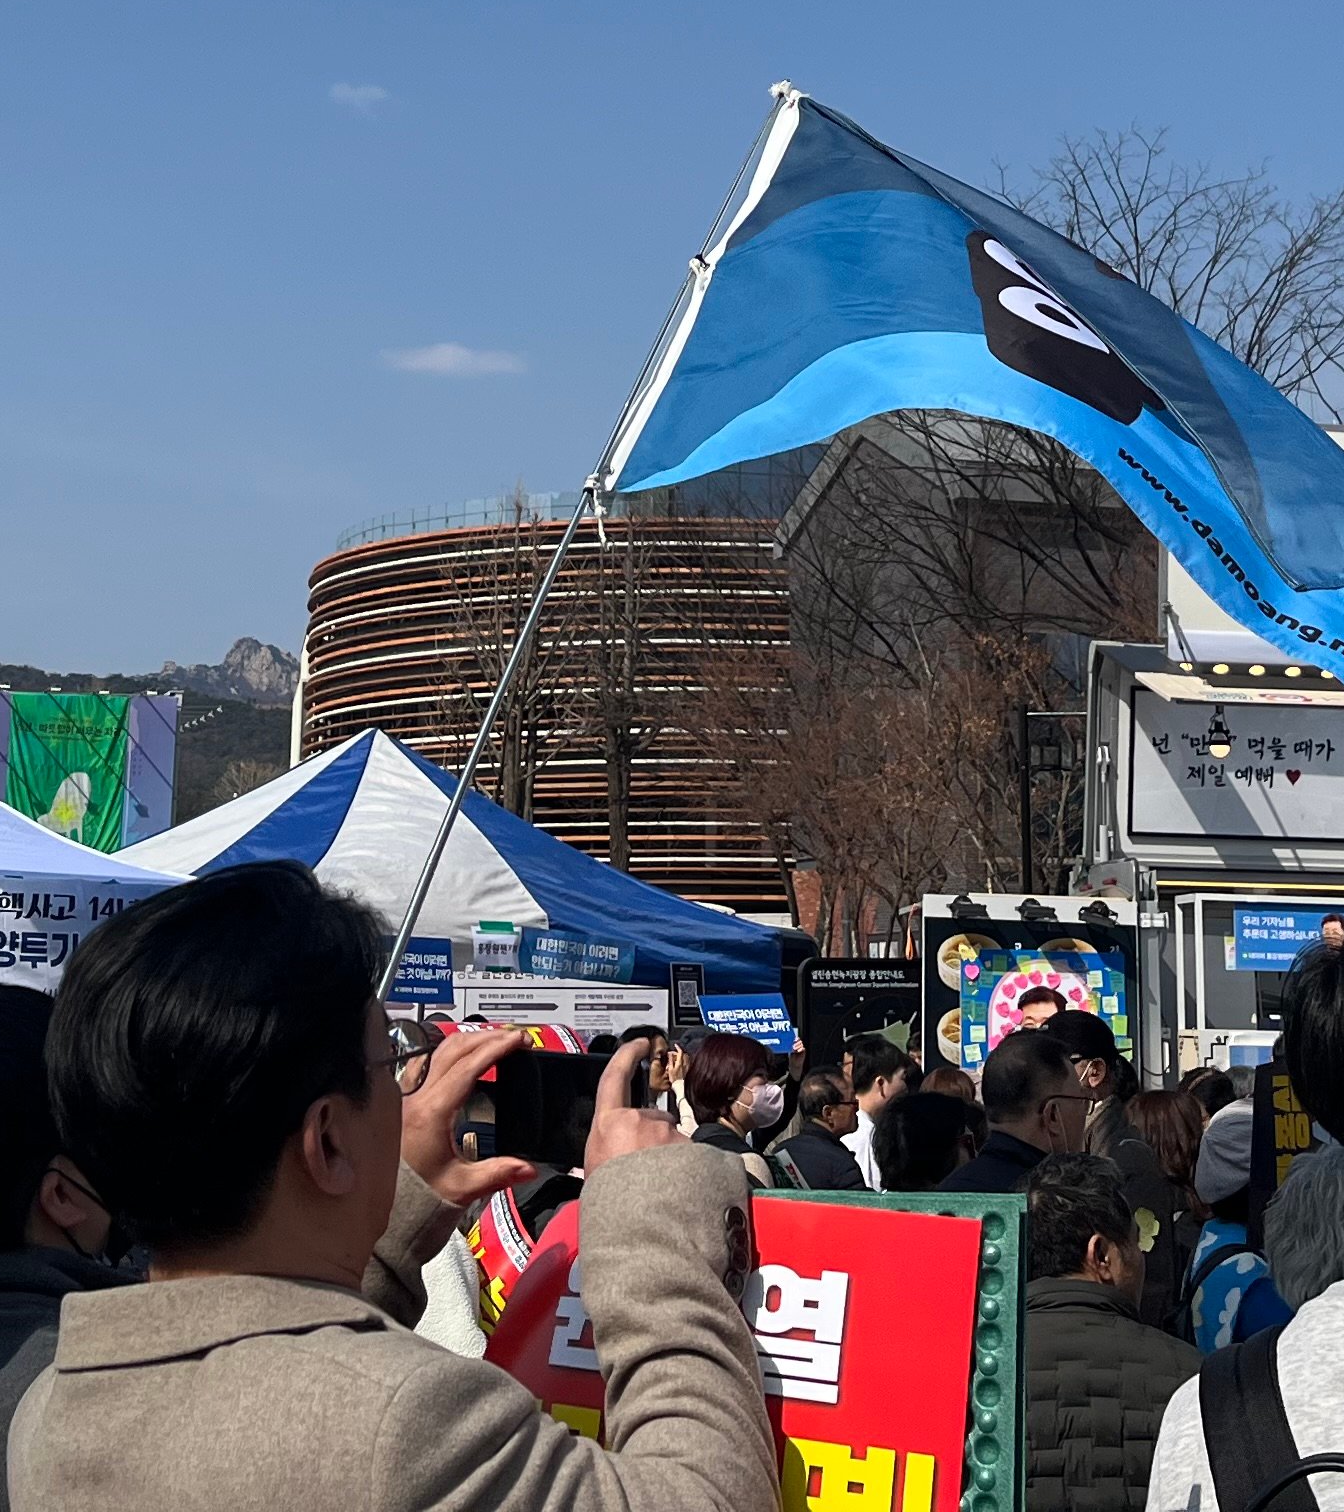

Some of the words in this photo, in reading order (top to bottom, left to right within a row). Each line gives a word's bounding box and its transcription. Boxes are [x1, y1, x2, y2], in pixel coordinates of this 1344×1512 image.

[1152, 734, 1172, 755] 넌
[1181, 733, 1237, 756] “만”
[1248, 737, 1287, 761] 먹을
[1294, 739, 1335, 762] 때가
[1187, 764, 1226, 787] 제일
[1242, 916, 1260, 927] 우리
[1262, 916, 1295, 928] 기자님들
[1242, 929, 1268, 940] 추운데
[536, 937, 586, 956] 대한민국이
[589, 944, 619, 961] 이러면
[707, 1009, 755, 1022] 대한민국이
[755, 1007, 784, 1020] 이러면
